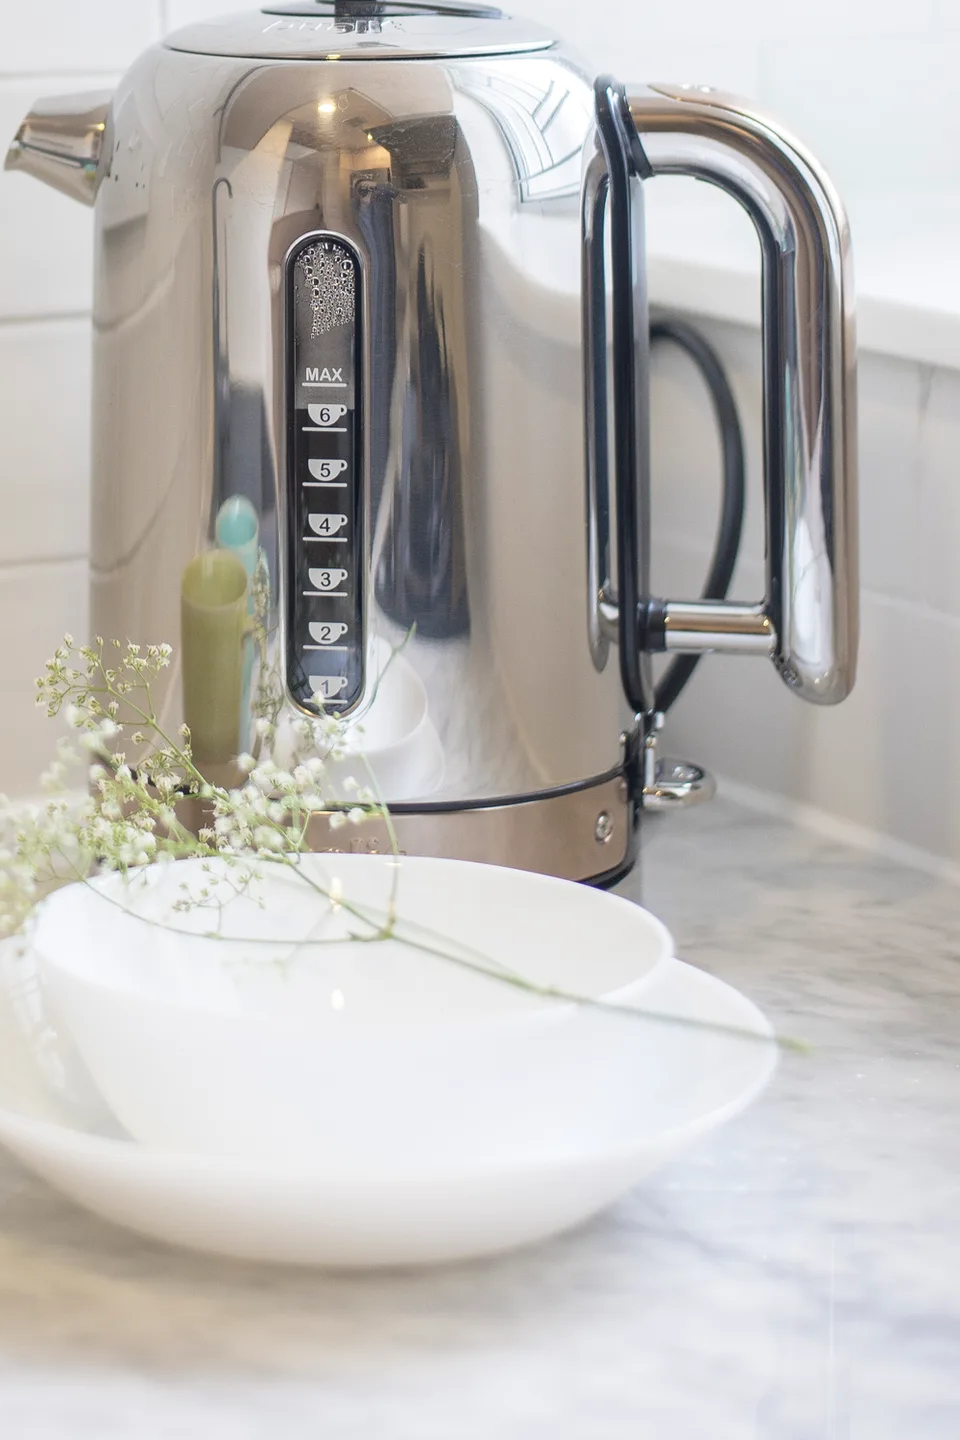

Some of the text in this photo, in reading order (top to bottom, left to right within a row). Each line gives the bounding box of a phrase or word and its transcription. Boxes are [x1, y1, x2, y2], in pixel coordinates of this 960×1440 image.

[305, 367, 343, 382] MAX
[320, 407, 331, 423] 6
[320, 462, 331, 478] 5
[319, 517, 331, 533] 4
[320, 571, 331, 587] 3
[320, 625, 331, 641] 2
